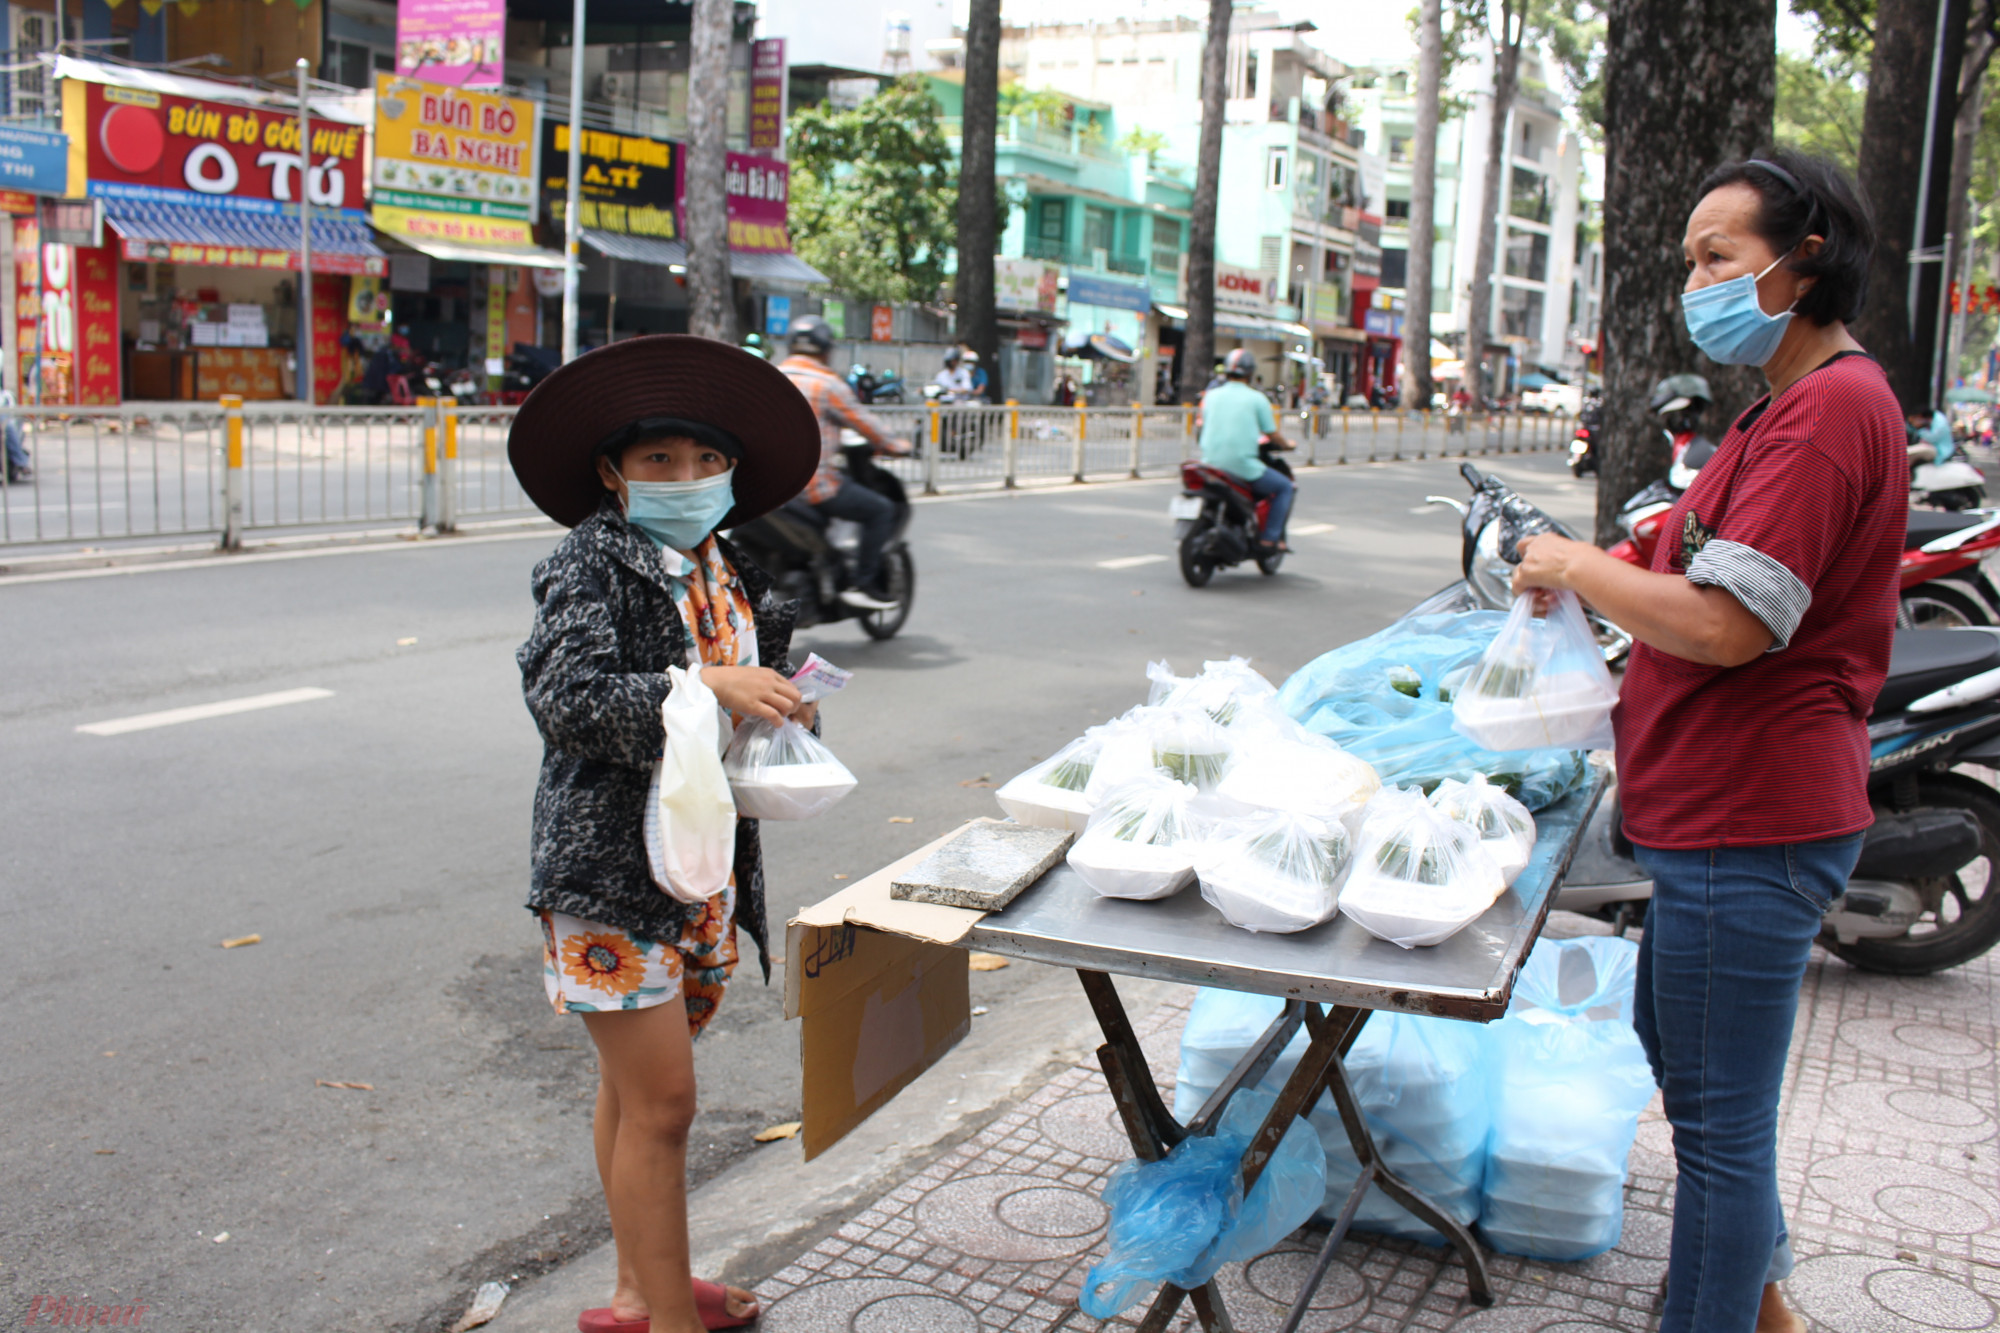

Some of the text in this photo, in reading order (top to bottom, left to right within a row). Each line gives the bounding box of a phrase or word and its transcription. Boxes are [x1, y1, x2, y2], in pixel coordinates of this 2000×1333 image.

[168, 104, 221, 139] BÚN
[227, 112, 259, 144] BÒ
[312, 127, 362, 159] HUẾ
[421, 87, 517, 137] BÚN BÒ
[183, 142, 239, 194] O
[411, 129, 522, 175] BA NGHỊ
